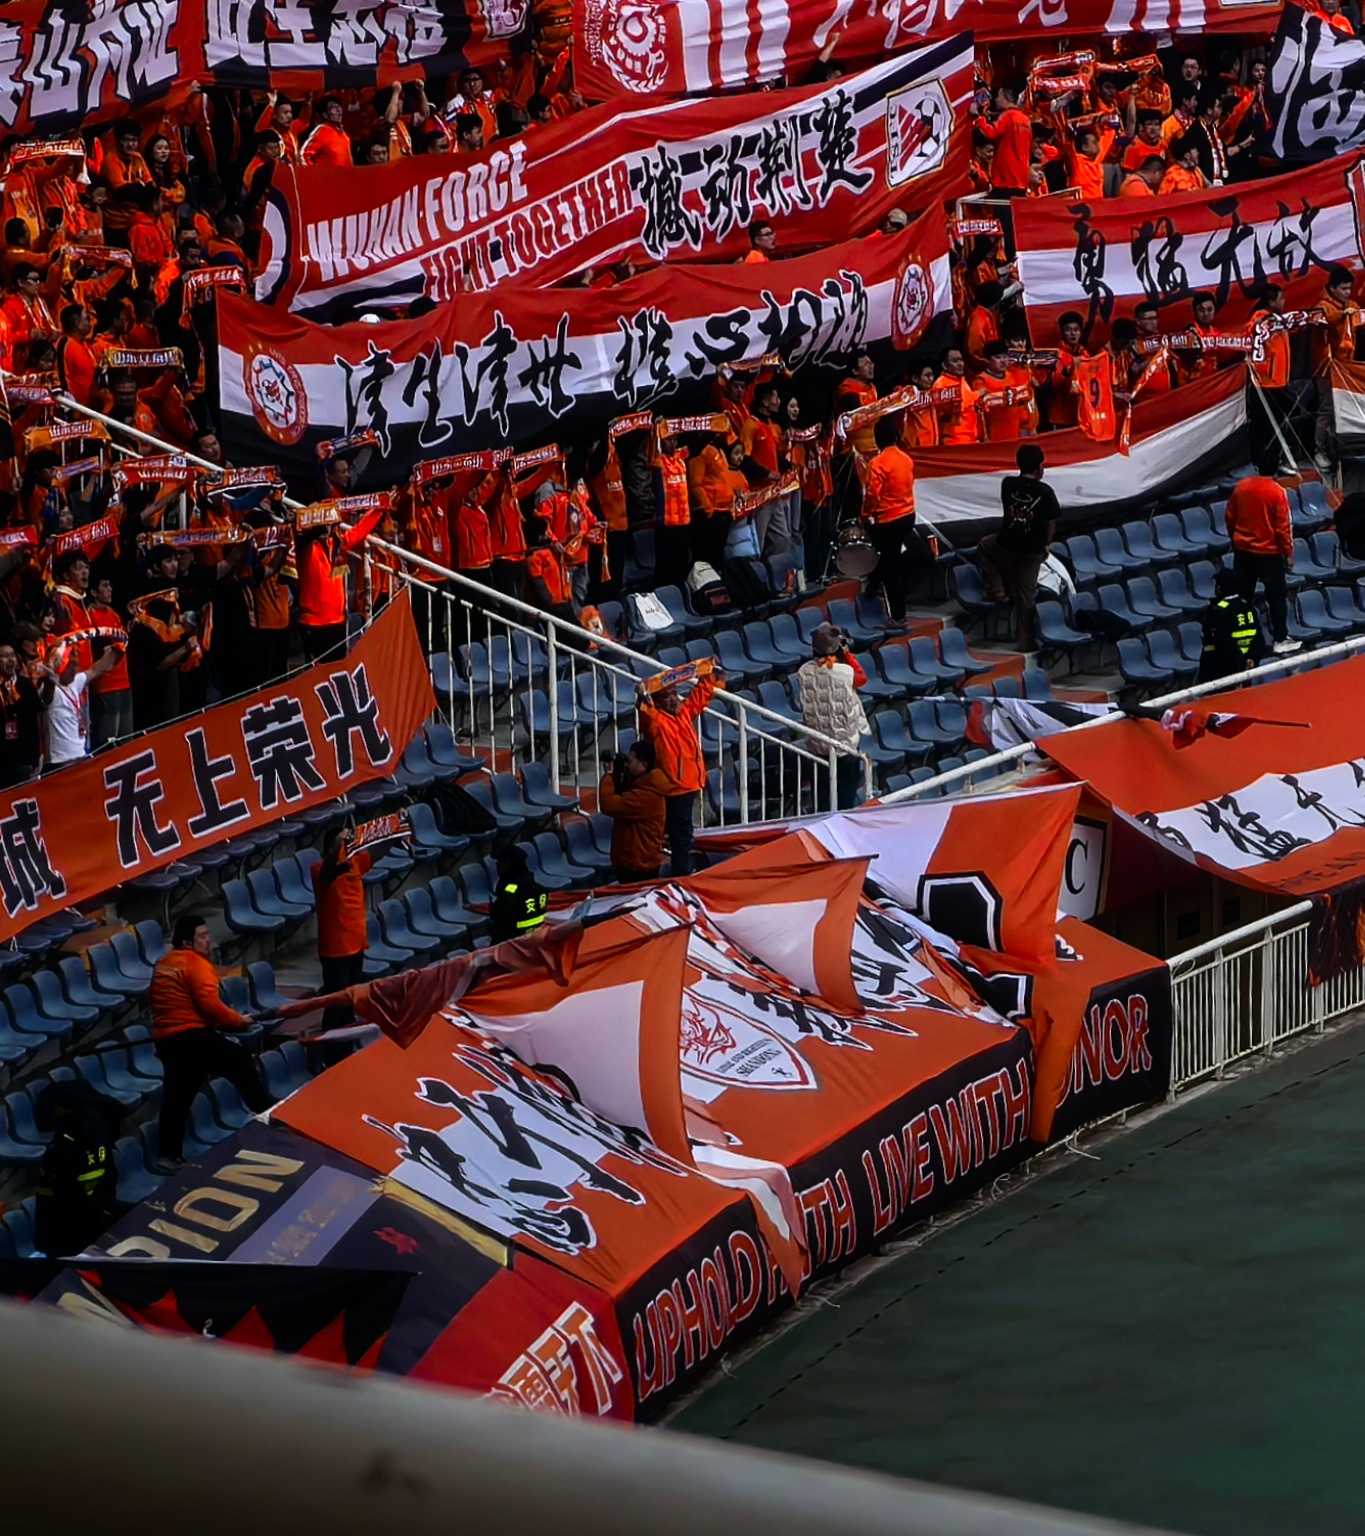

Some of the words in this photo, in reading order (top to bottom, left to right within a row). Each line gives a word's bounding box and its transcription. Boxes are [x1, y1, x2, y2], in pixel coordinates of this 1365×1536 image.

[104, 663, 395, 870] 无上荣光
[635, 1229, 763, 1403] UPHOLD
[862, 1113, 935, 1238] LIVE
[928, 1057, 1031, 1187] WITH
